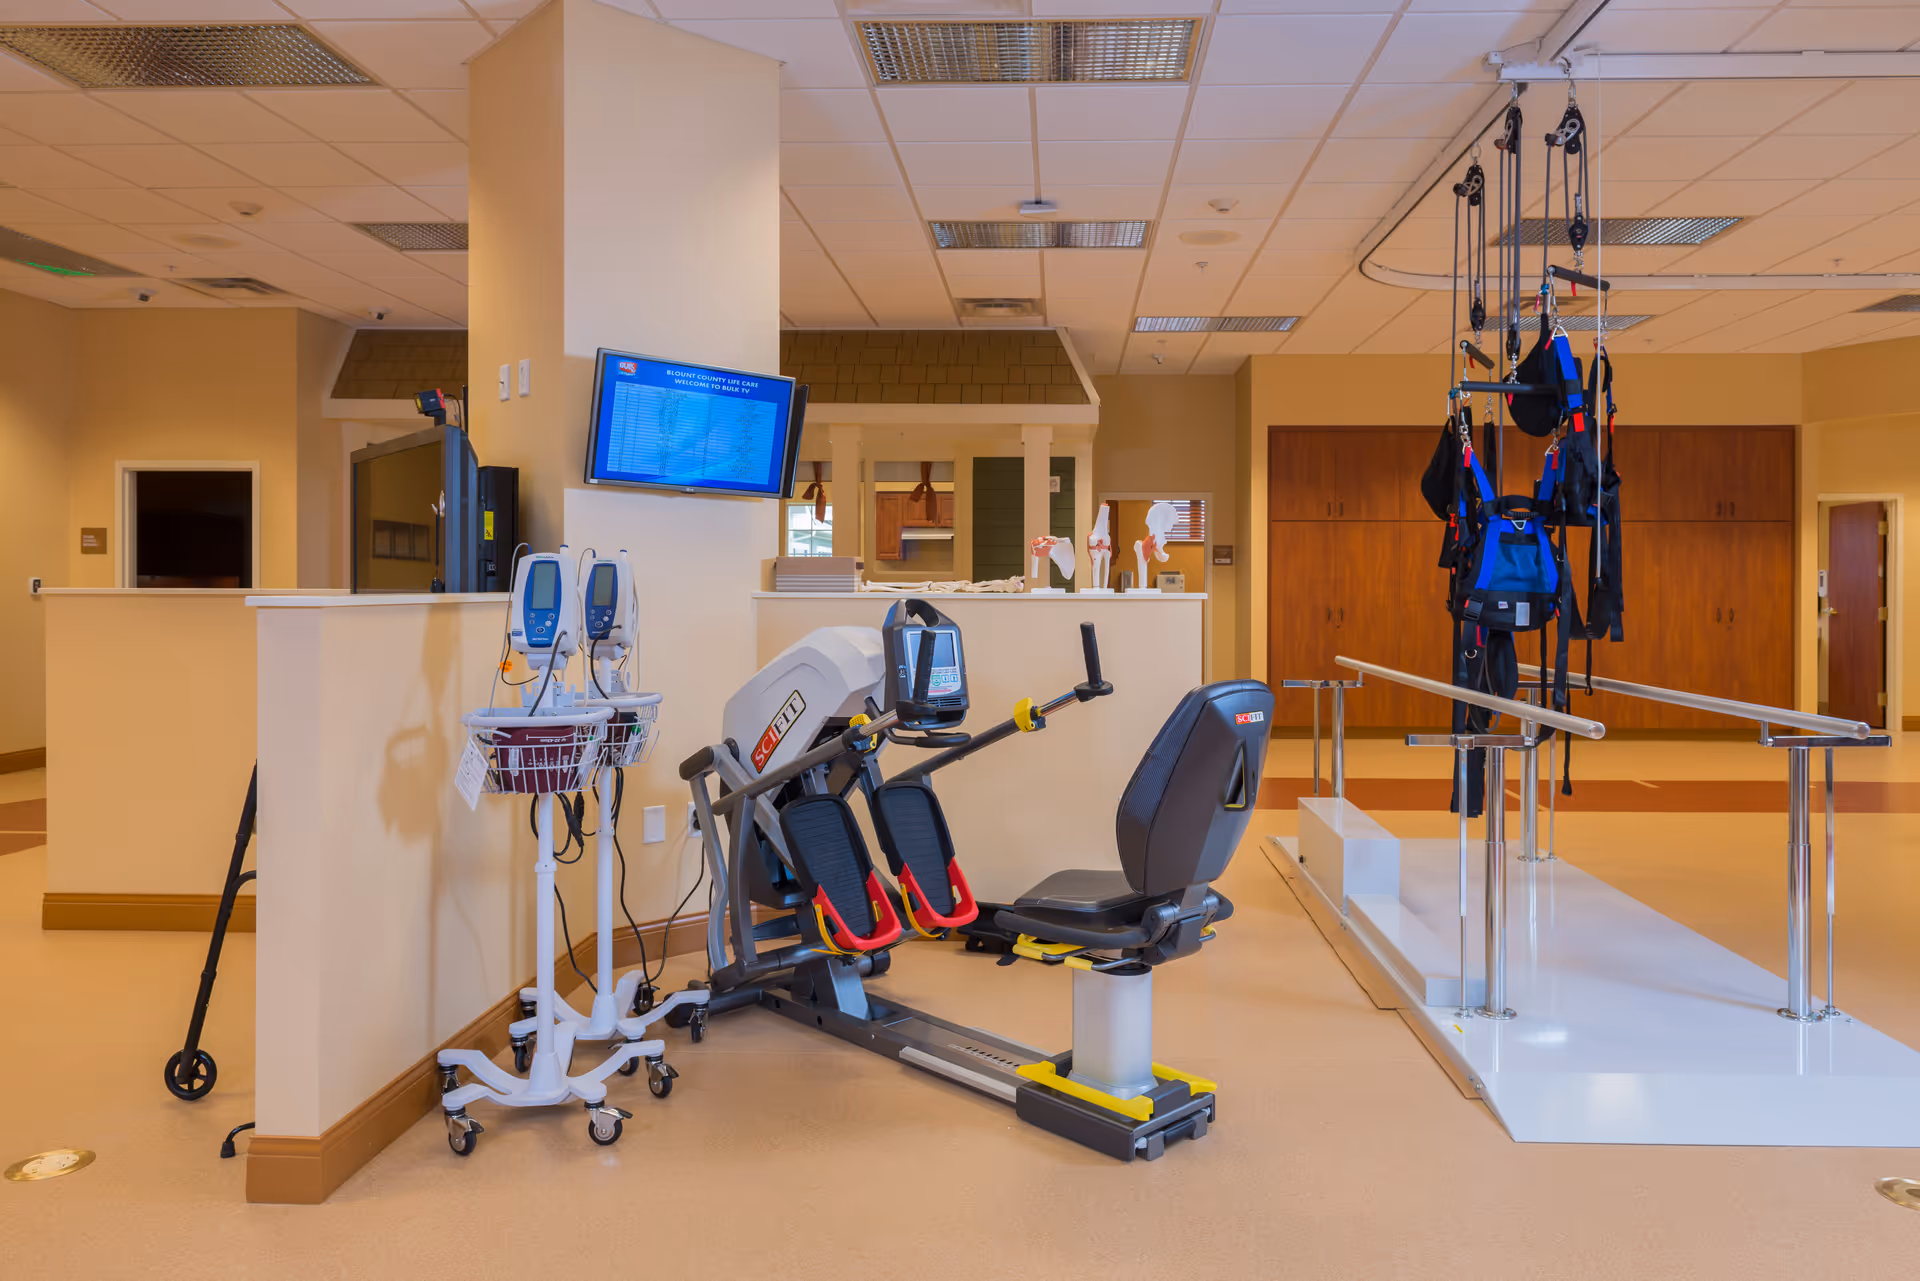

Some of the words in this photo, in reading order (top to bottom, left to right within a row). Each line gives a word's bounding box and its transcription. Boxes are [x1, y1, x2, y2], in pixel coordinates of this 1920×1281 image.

[666, 369, 696, 379] BLOUNT
[697, 374, 726, 383] COUNTY
[727, 378, 740, 386] LIFE
[674, 378, 709, 388] WELCOME
[1237, 713, 1262, 723] SCIFIT
[755, 697, 798, 766] SCIFIT
